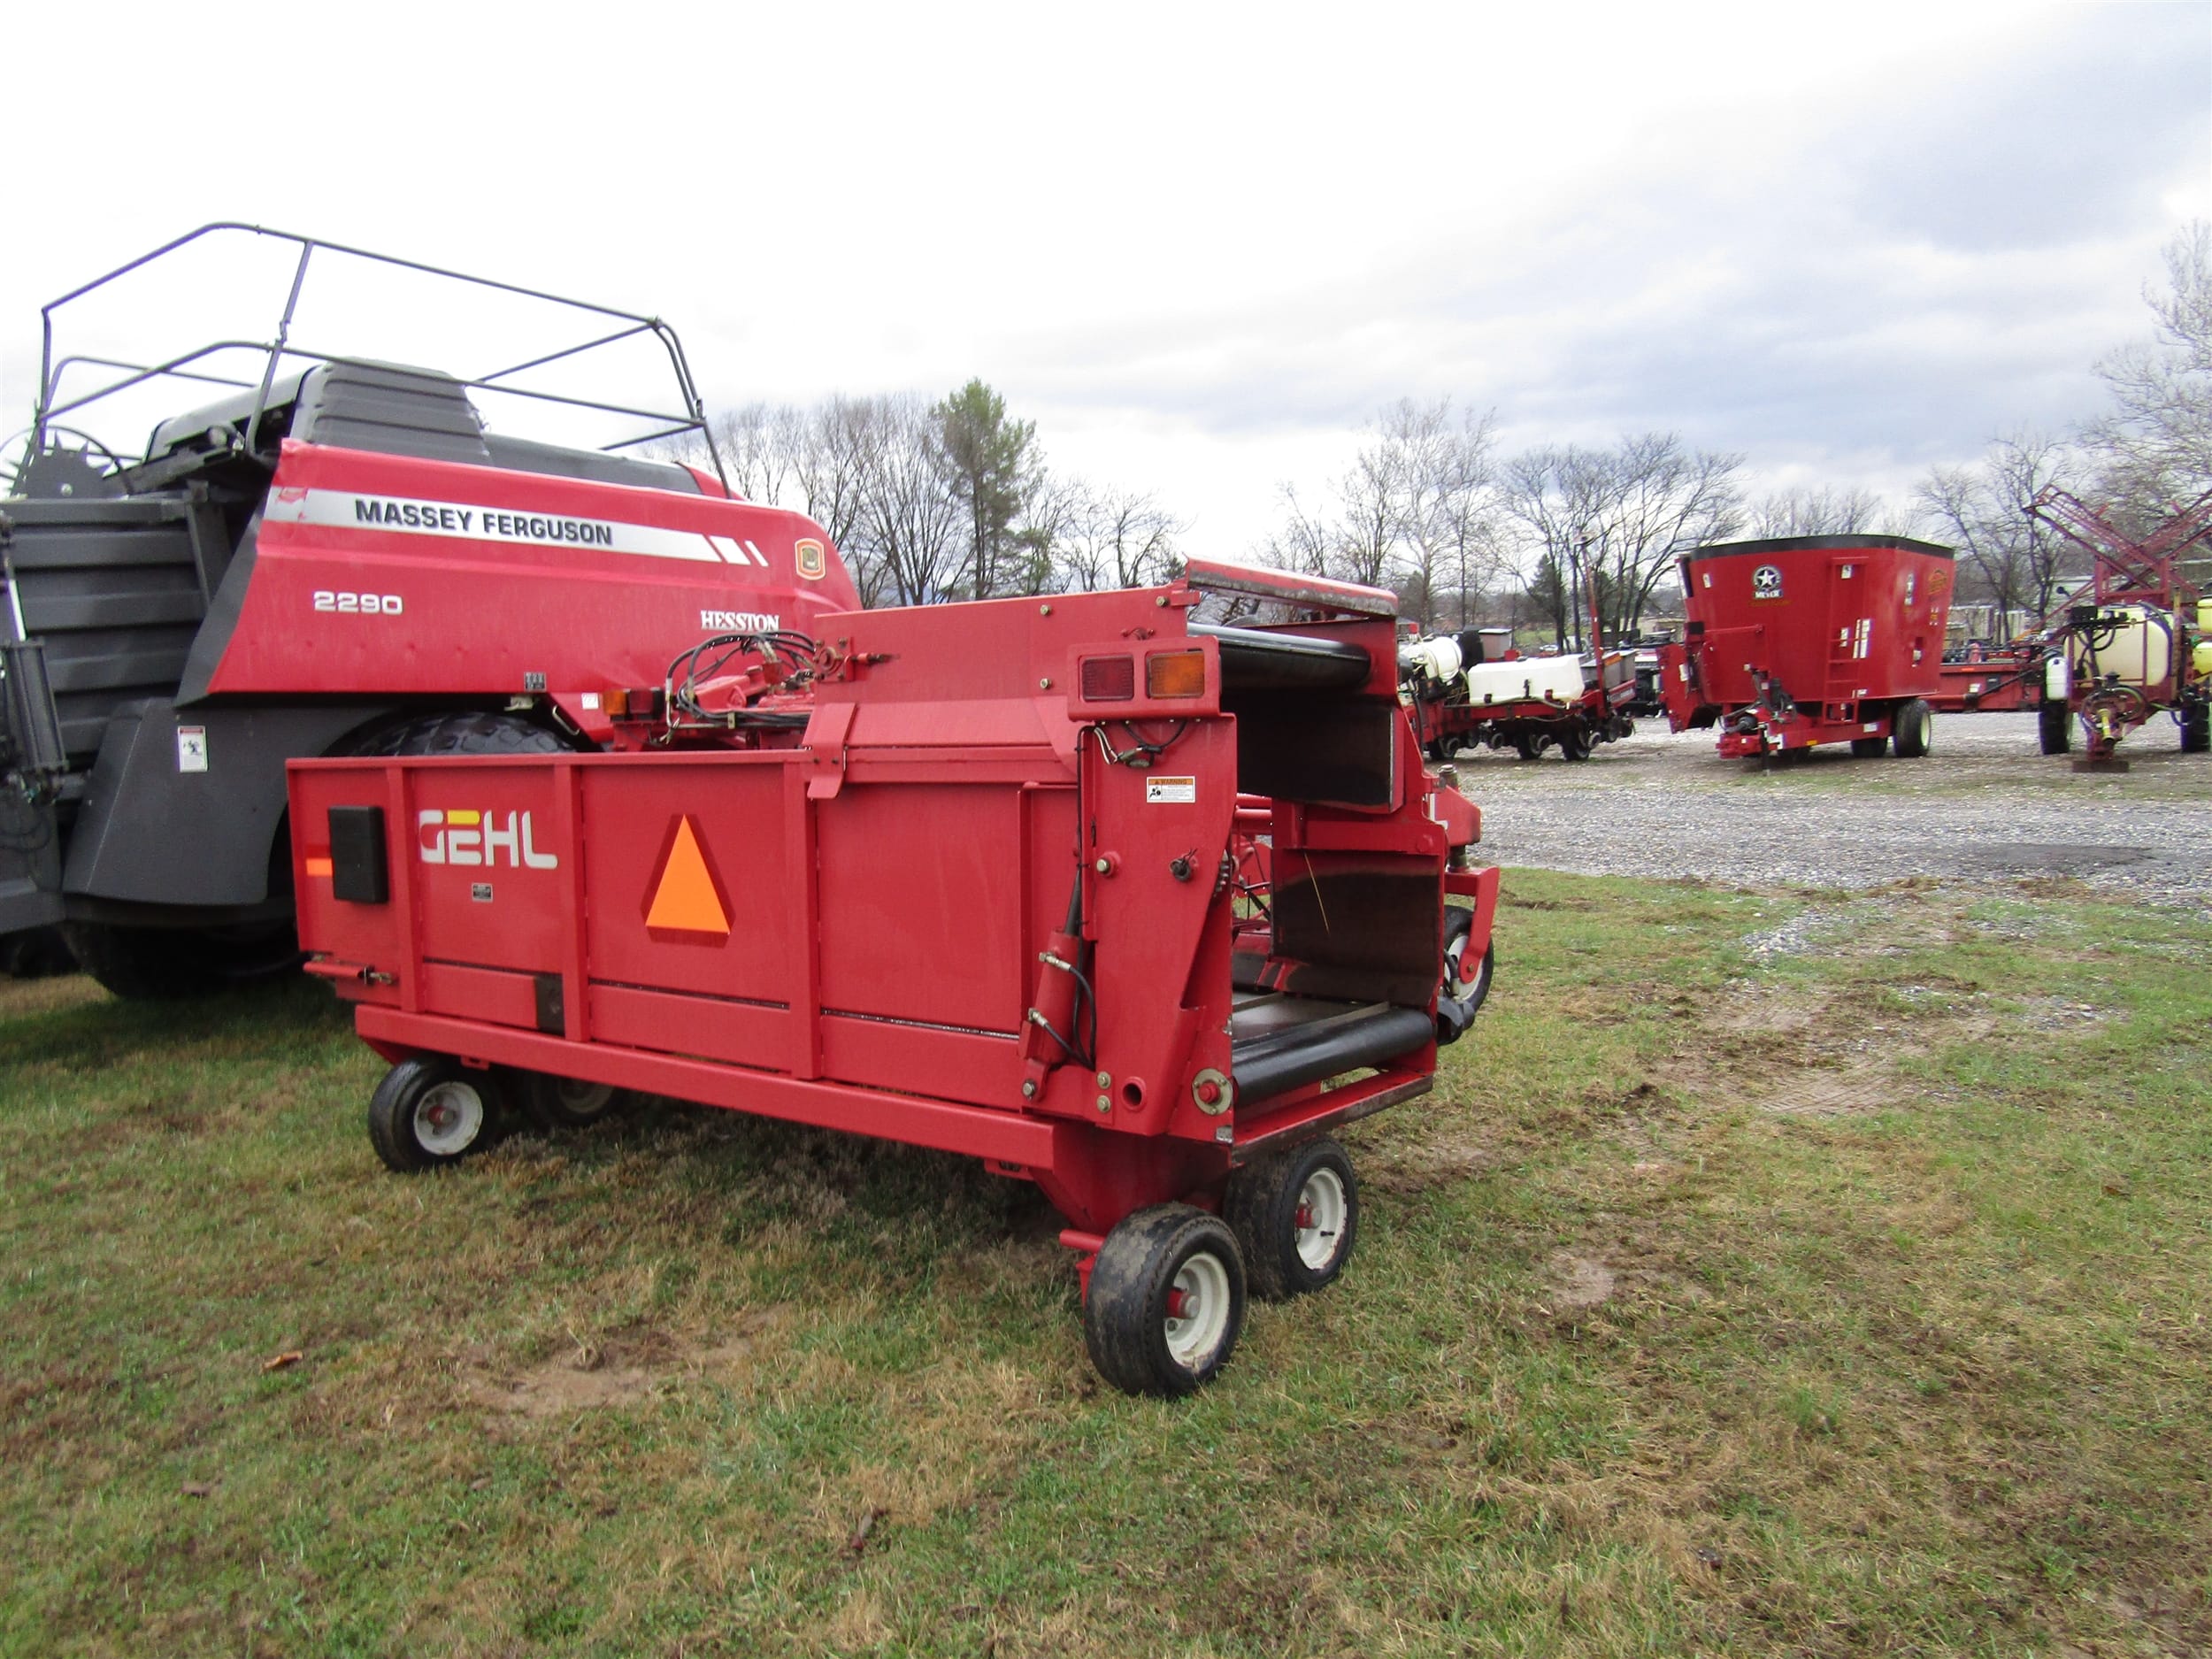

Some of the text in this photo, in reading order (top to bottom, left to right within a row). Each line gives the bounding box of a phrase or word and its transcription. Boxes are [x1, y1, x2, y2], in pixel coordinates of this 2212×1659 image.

[355, 499, 612, 546] MASSEY FERGUSON
[313, 590, 403, 615] 2290
[700, 610, 780, 633] HESSTON
[419, 810, 558, 870] GEHL
